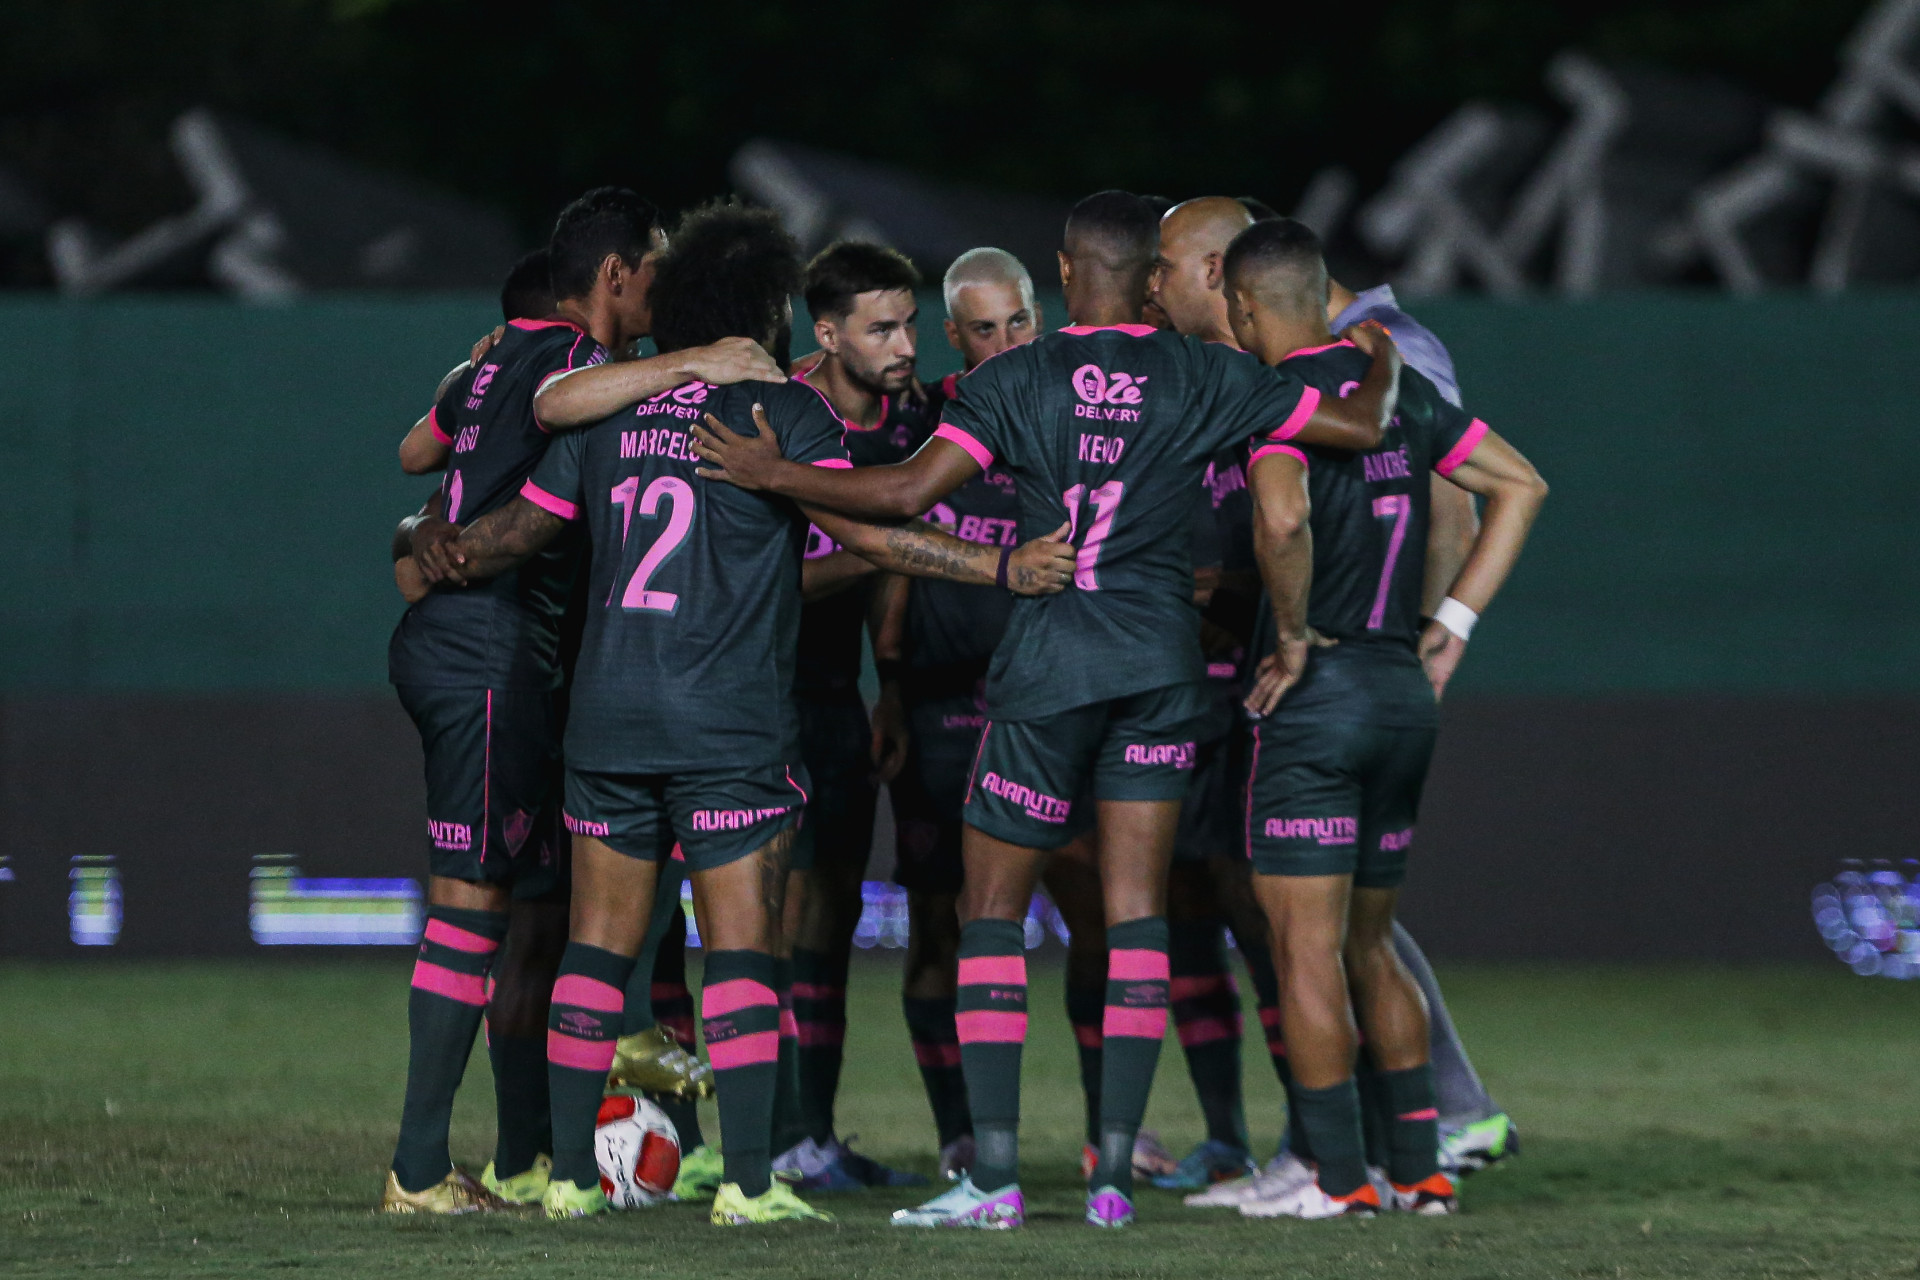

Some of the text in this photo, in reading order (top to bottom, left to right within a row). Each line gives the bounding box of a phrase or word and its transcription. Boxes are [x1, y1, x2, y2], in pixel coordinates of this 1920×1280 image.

[636, 403, 700, 419] DELIVERY
[605, 475, 696, 612] 12
[1062, 480, 1125, 592] 11
[1365, 492, 1412, 630] 7
